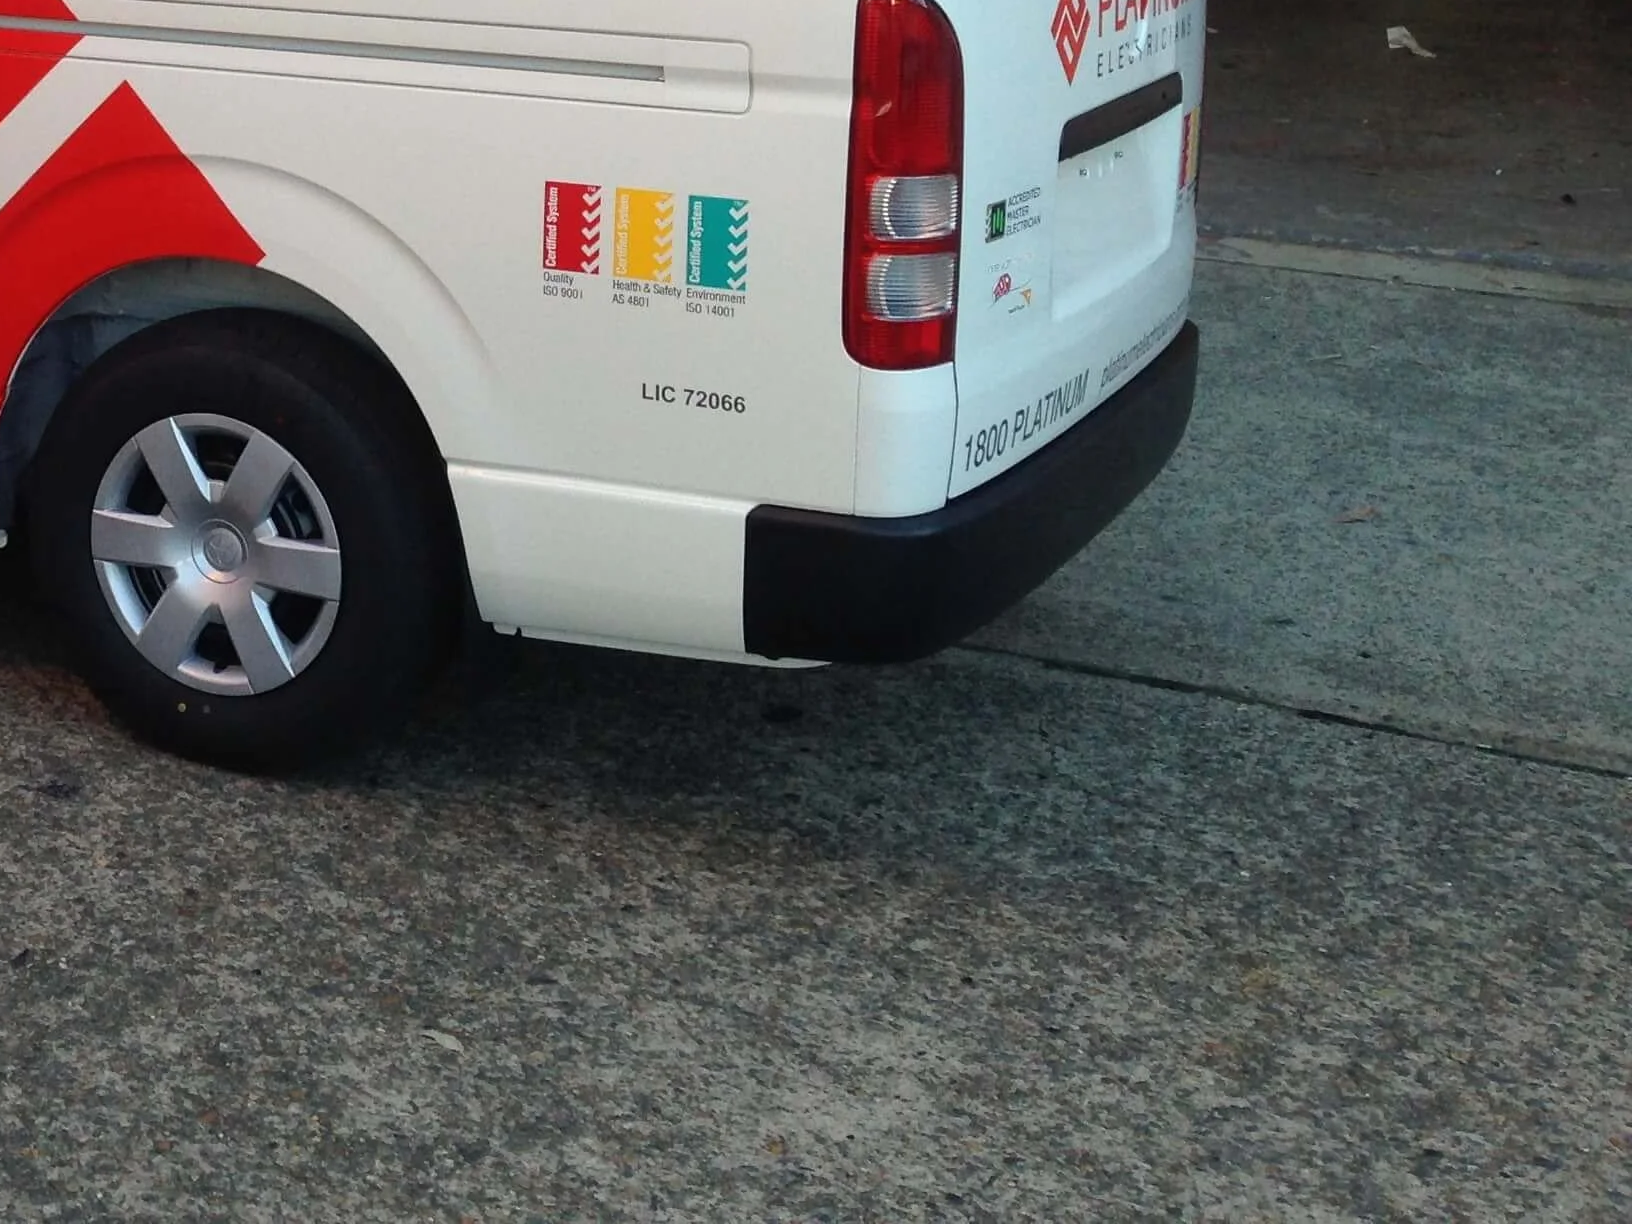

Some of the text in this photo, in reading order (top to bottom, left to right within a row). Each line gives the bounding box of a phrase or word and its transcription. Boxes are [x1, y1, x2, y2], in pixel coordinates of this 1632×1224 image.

[546, 187, 559, 267] Certified System
[689, 201, 703, 282] Certified System
[543, 272, 574, 286] Quality
[543, 286, 583, 299] ISO 9001
[612, 280, 641, 292] Health
[653, 283, 682, 298] Safety
[686, 288, 746, 304] Environment
[612, 294, 649, 308] AS 4801
[686, 302, 735, 318] ISO 14001
[642, 382, 746, 413] LIC 72066
[965, 368, 1089, 472] 1800 PLATINUM
